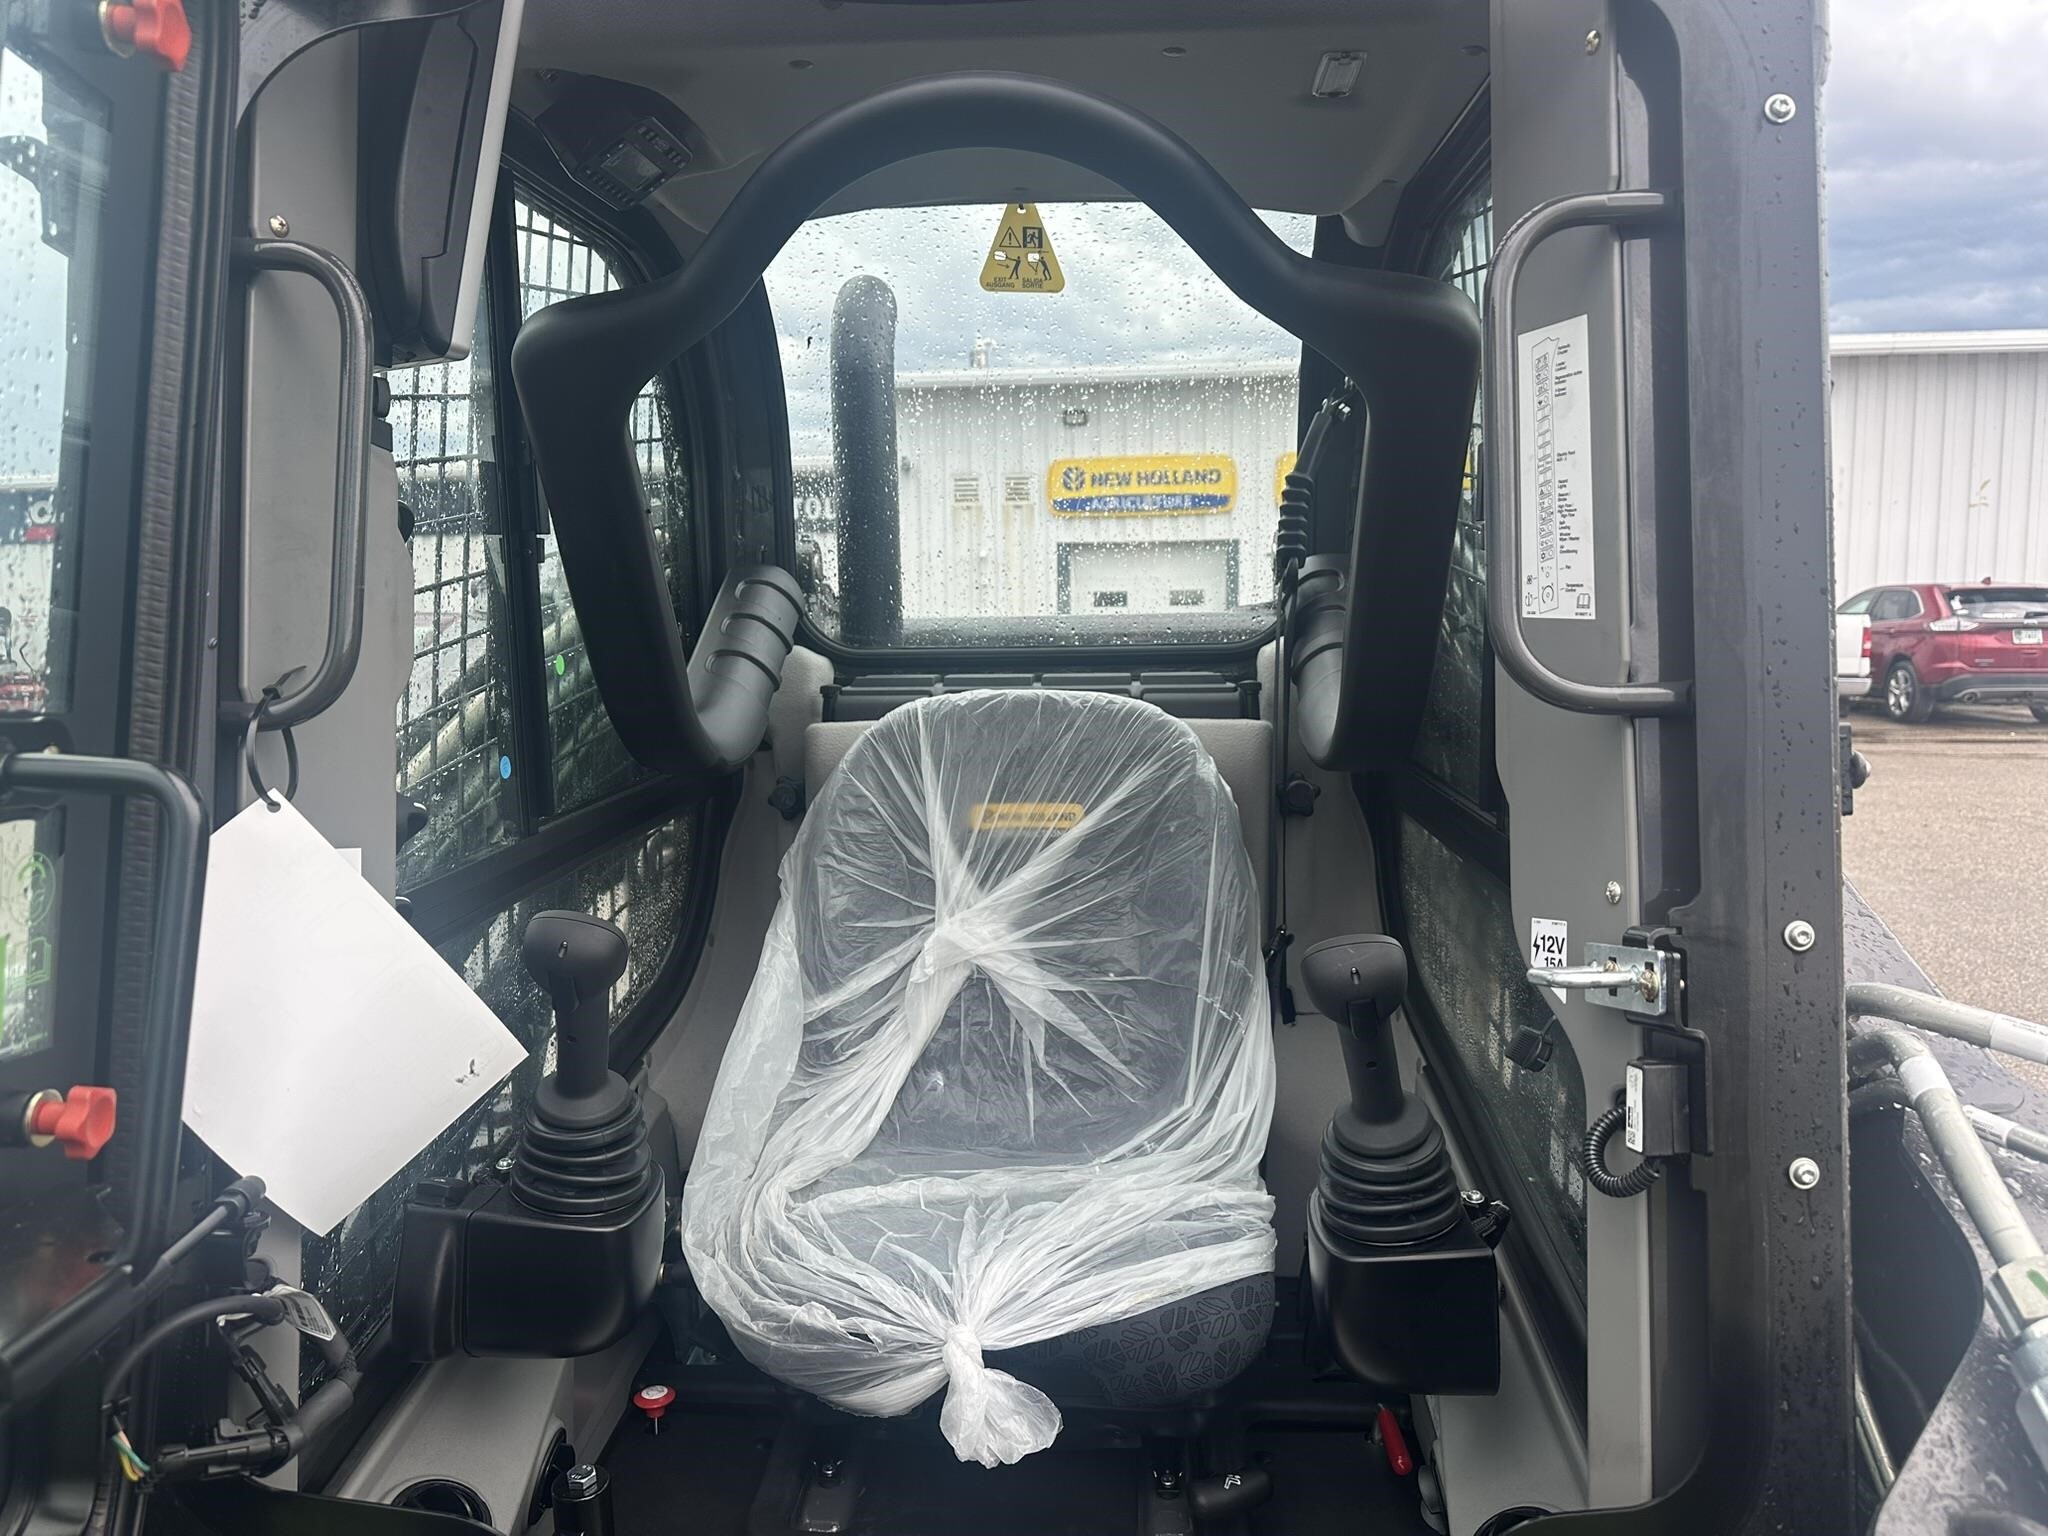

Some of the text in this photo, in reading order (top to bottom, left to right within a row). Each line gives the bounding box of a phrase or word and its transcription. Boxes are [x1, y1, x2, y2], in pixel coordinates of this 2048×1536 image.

[1090, 468, 1222, 487] NEW HOLLAND
[1540, 934, 1565, 954] 12V
